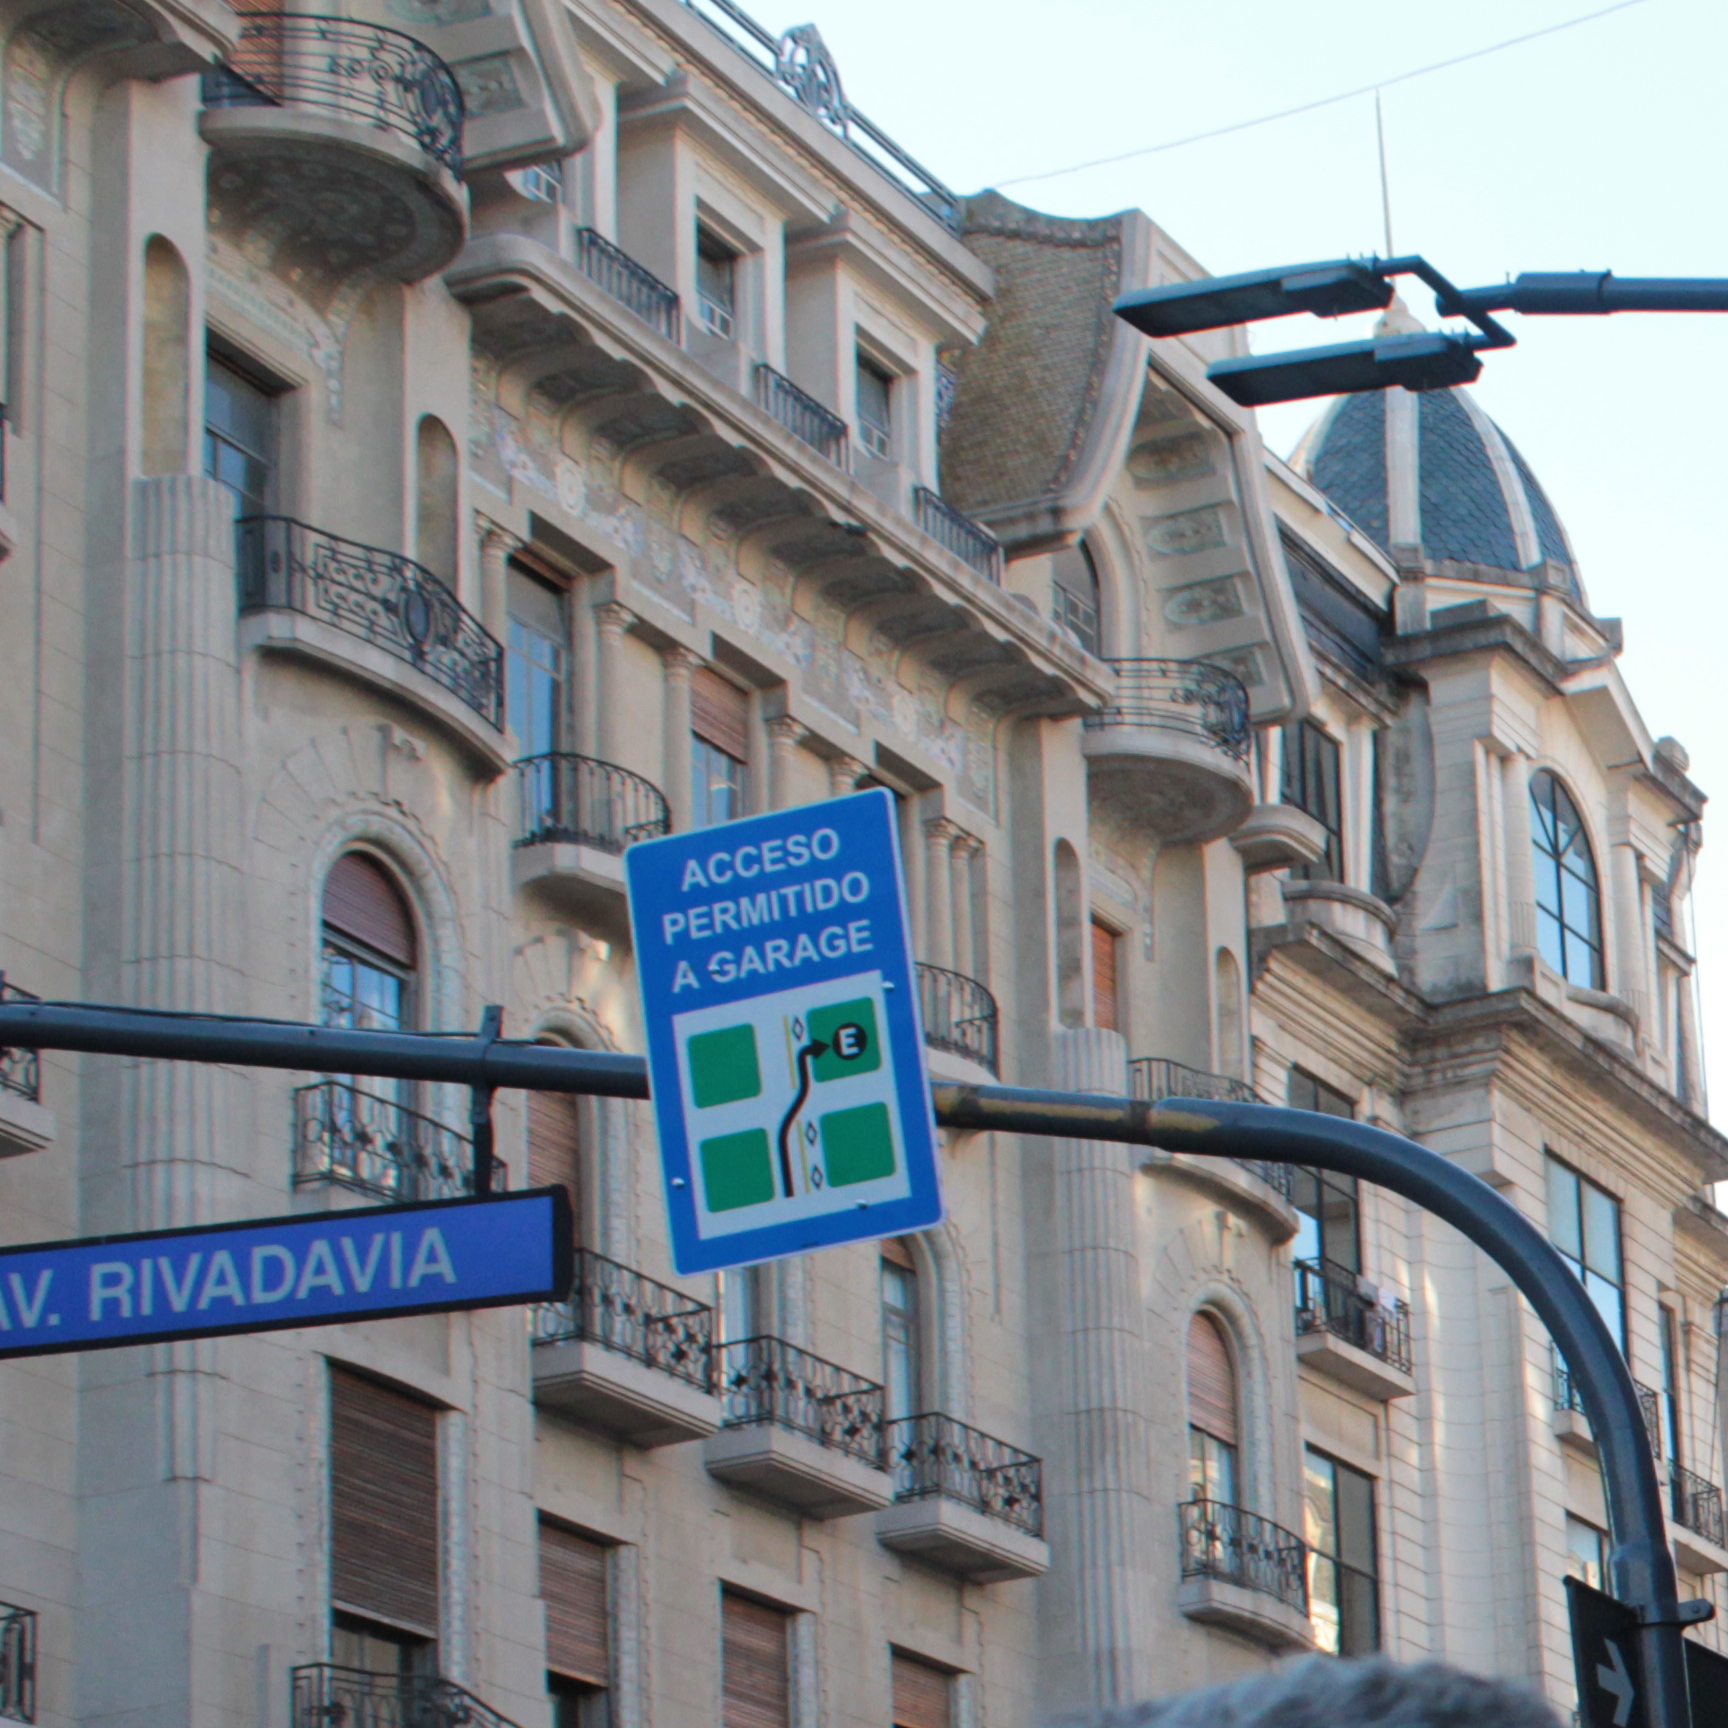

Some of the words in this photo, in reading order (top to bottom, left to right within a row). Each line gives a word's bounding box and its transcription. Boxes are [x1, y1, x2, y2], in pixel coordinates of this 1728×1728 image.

[681, 827, 840, 892] ACCESO
[661, 870, 870, 946] PERMITIDO
[671, 960, 701, 994] A
[707, 919, 875, 984] GARAGE
[88, 1226, 458, 1322] RIVADAVIA
